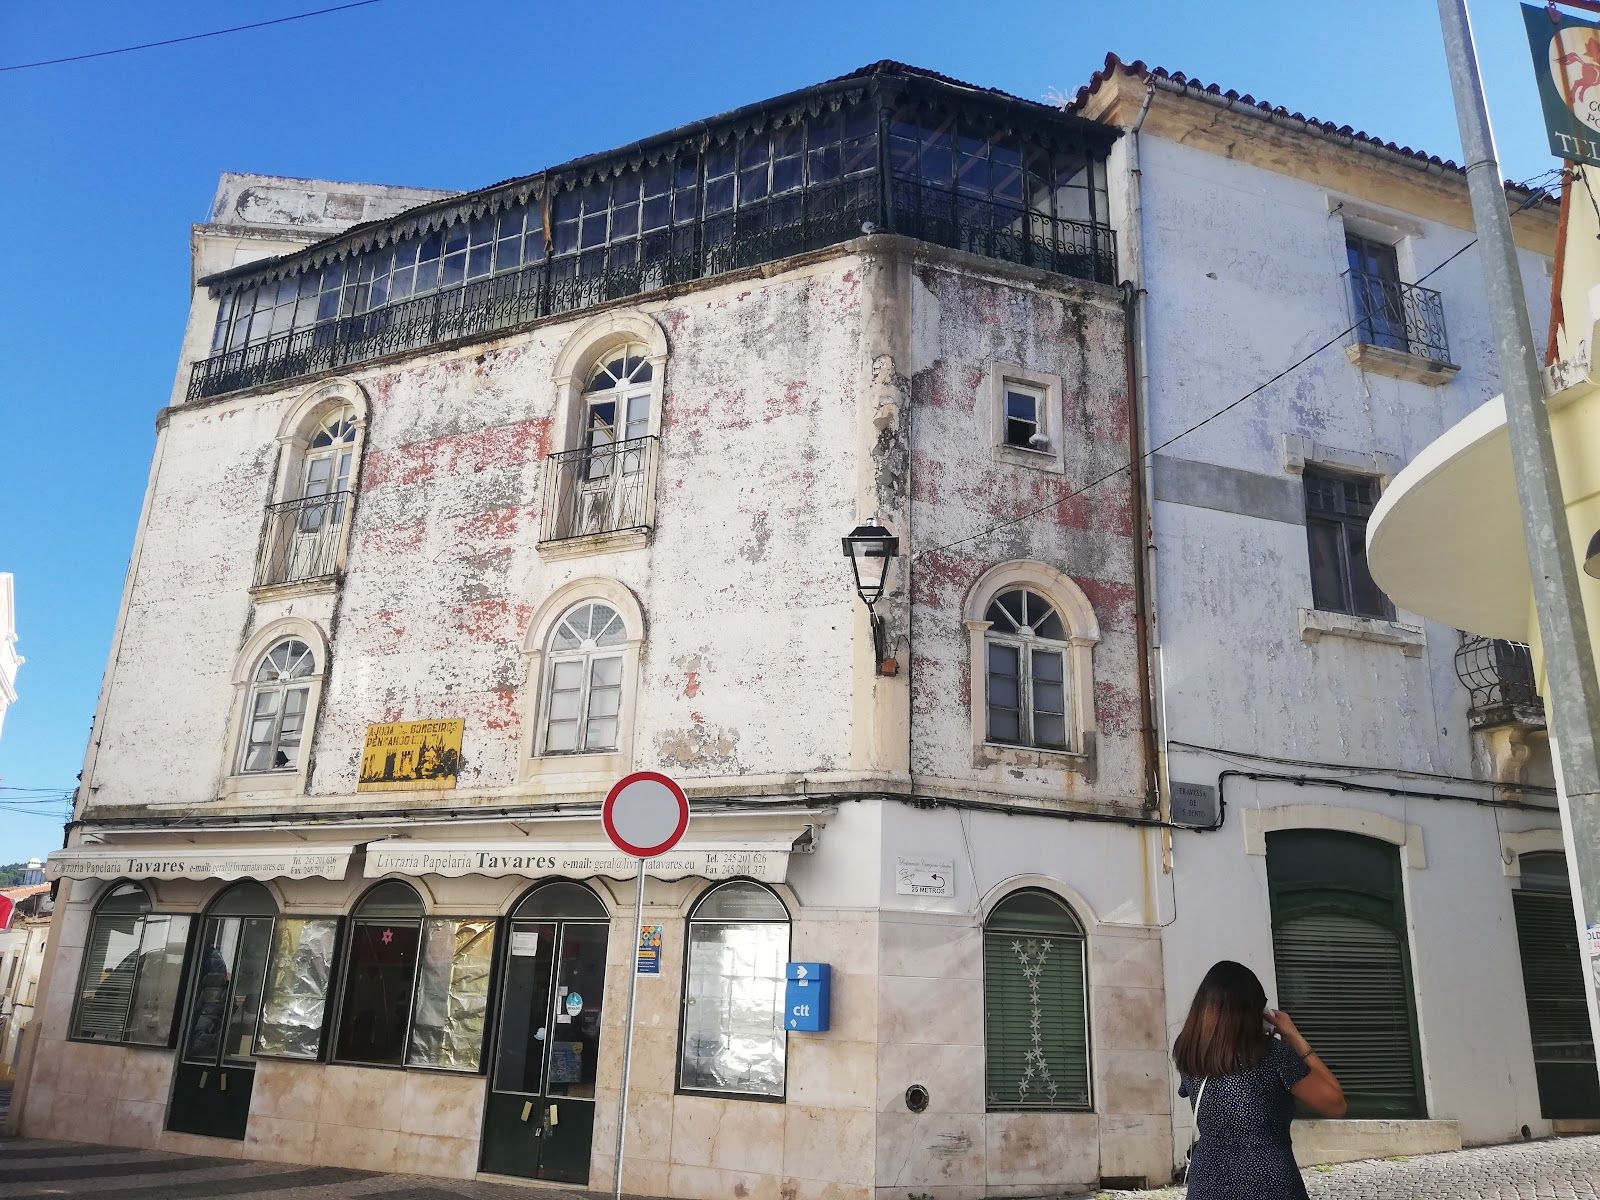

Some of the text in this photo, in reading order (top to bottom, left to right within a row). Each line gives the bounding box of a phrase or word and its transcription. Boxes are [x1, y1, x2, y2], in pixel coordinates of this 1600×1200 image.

[377, 854, 419, 869] Livraria
[423, 854, 472, 871] Papelaria
[476, 852, 556, 869] Tavares
[562, 857, 592, 870] e-mail:
[706, 854, 719, 863] Tel.
[724, 854, 736, 863] 245
[86, 860, 121, 877] Papelaria
[126, 858, 185, 873] Tavares
[793, 1004, 810, 1017] ctt
